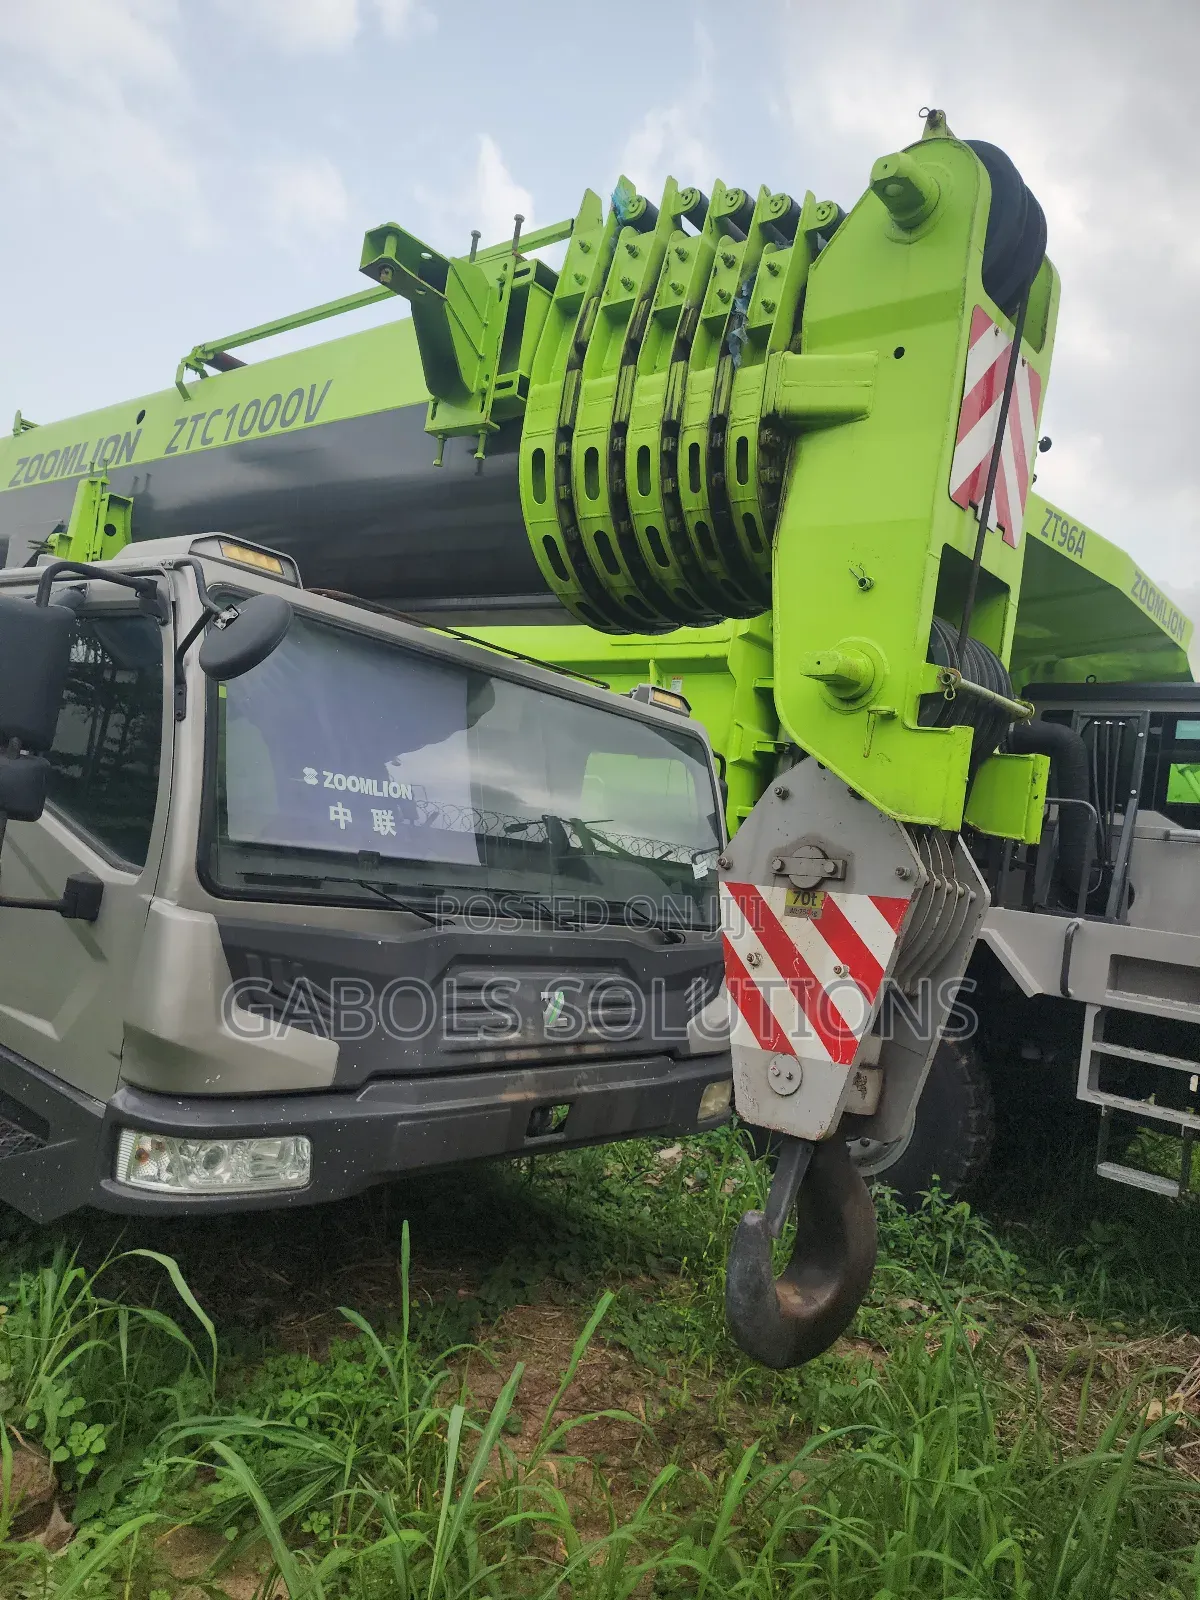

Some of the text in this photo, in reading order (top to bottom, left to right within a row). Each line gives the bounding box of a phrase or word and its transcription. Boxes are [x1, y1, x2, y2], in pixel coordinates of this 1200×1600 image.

[163, 379, 333, 455] ZTC1000V
[8, 428, 142, 487] ZOOMLION
[1040, 508, 1087, 559] ZT96A
[1130, 570, 1186, 642] ZOOMLION
[322, 770, 413, 800] ZOOMLION
[792, 890, 817, 906] 70t
